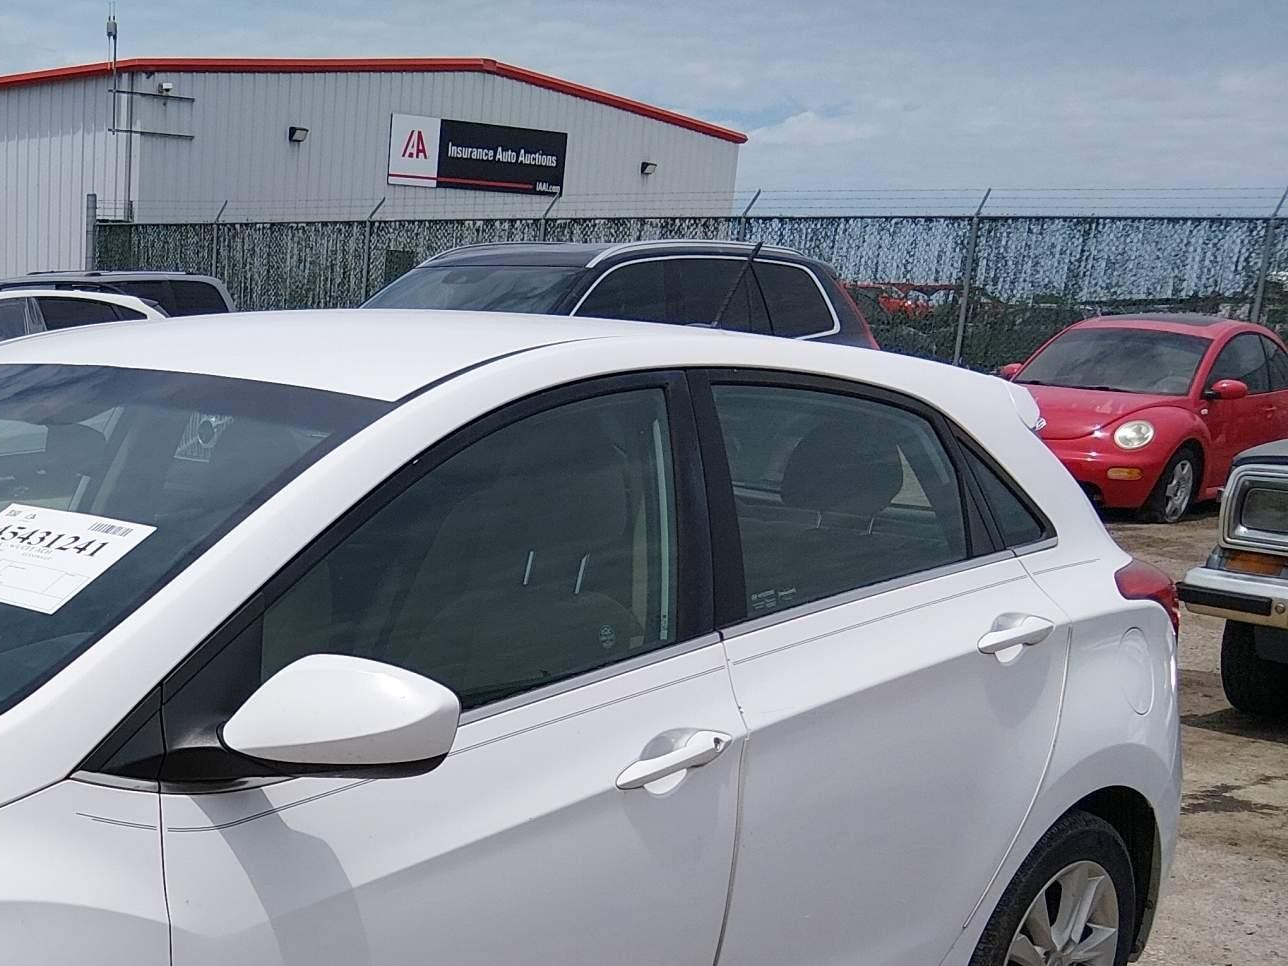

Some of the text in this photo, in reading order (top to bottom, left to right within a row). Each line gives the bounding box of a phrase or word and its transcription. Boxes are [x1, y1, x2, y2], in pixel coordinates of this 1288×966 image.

[447, 141, 557, 167] Insurance Auto Auctions
